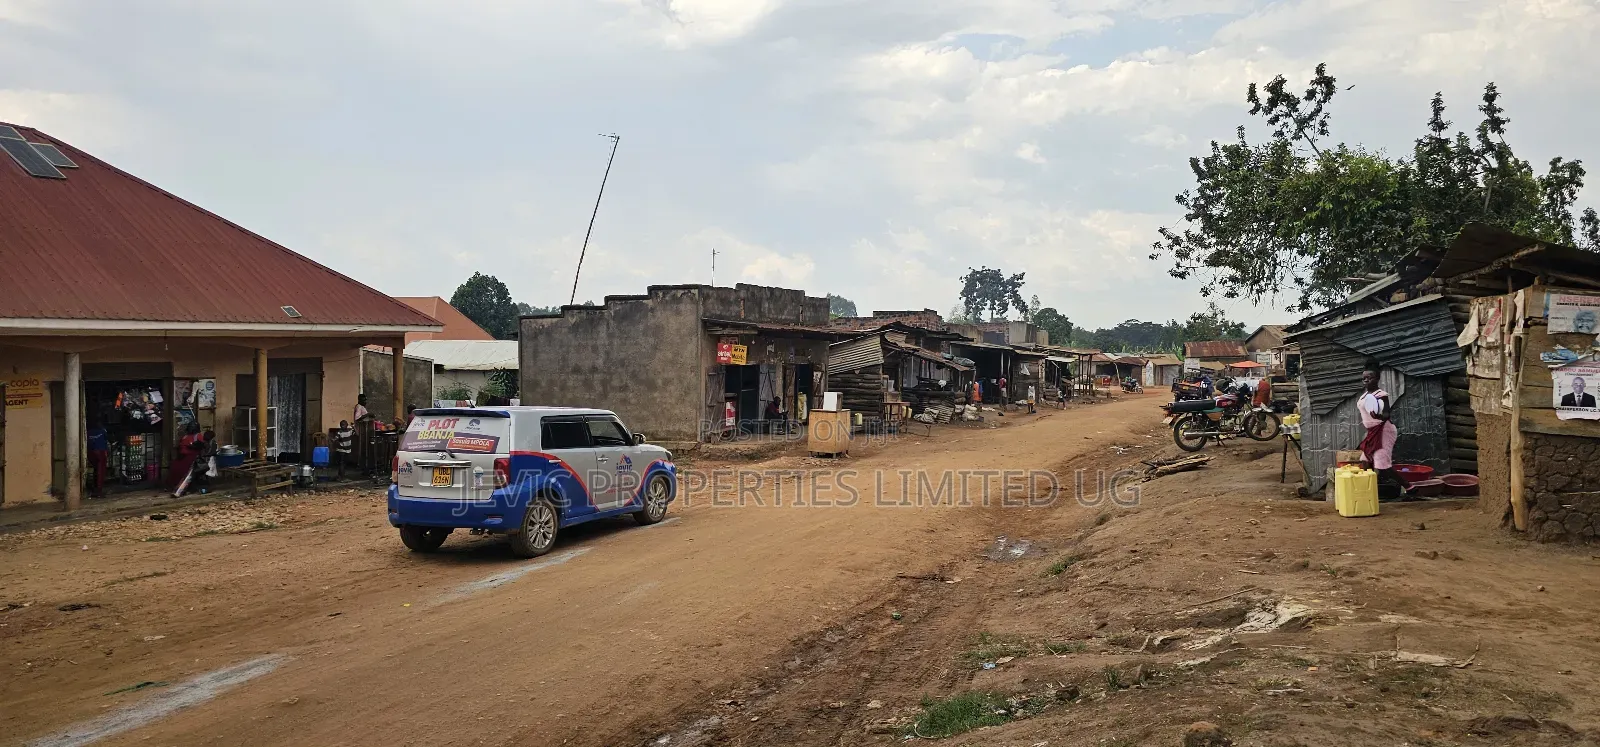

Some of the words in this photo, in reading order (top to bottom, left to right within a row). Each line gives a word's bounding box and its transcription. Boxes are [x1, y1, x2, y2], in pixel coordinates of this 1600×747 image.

[10, 378, 40, 388] copia
[427, 418, 460, 430] PLOT
[417, 430, 455, 440] BBANJA
